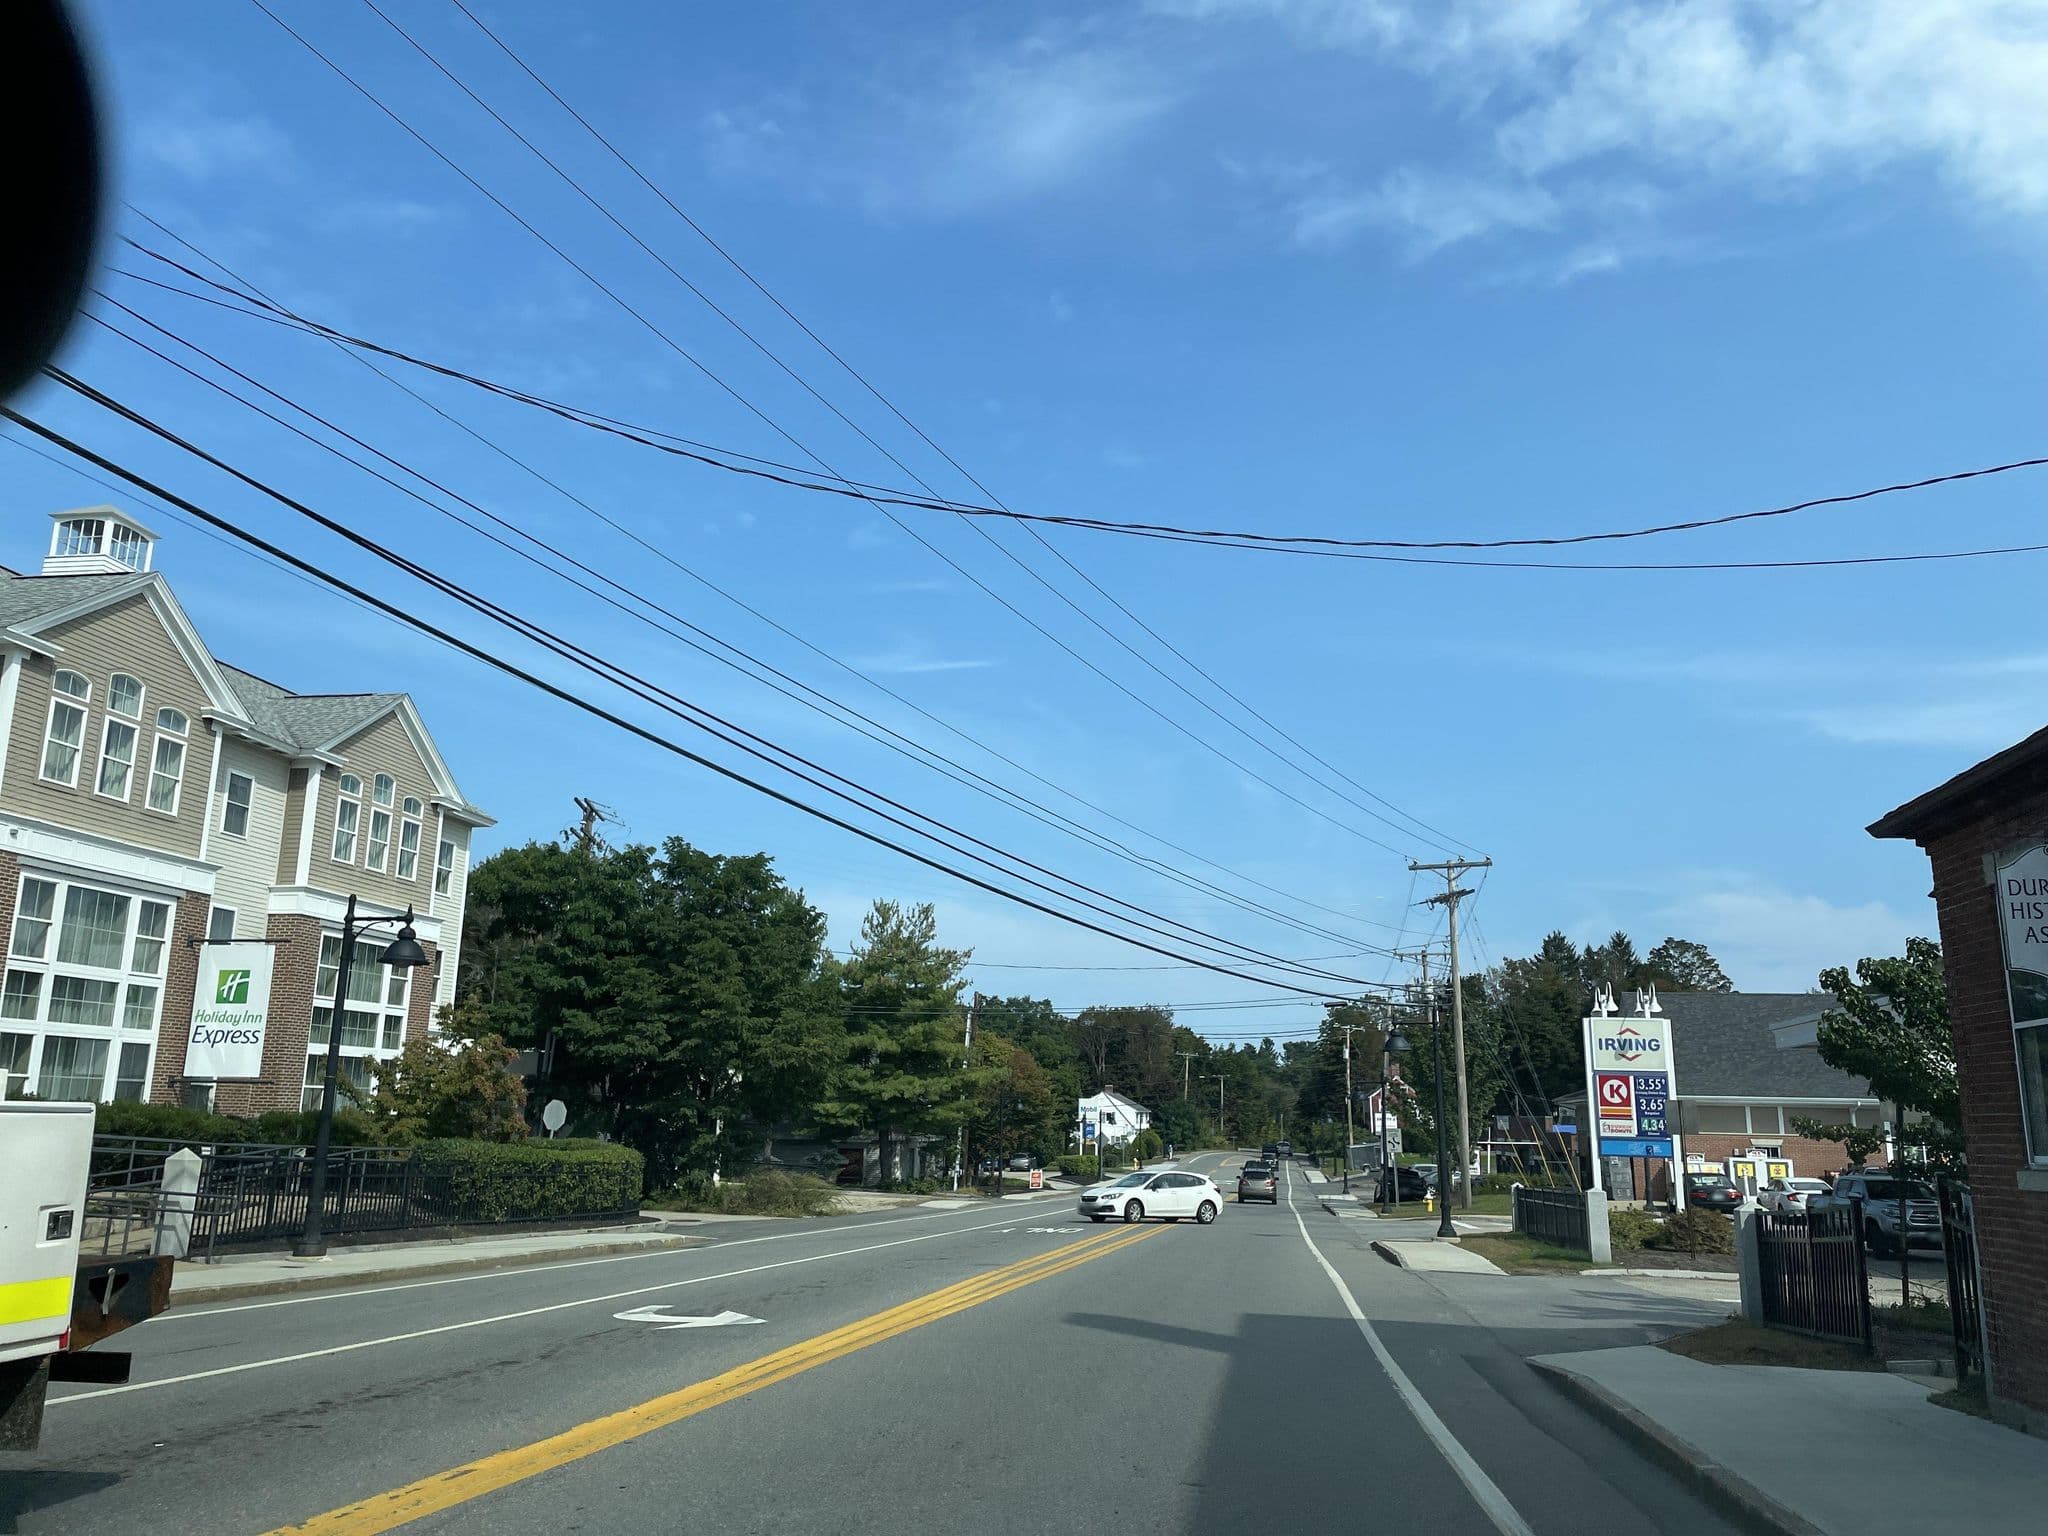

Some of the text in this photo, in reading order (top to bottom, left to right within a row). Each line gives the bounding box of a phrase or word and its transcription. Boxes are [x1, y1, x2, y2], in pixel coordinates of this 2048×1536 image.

[2010, 902, 2048, 920] HIS
[195, 1009, 263, 1027] Holiday Inn
[191, 1025, 261, 1049] Express
[1598, 1038, 1661, 1052] IRVING
